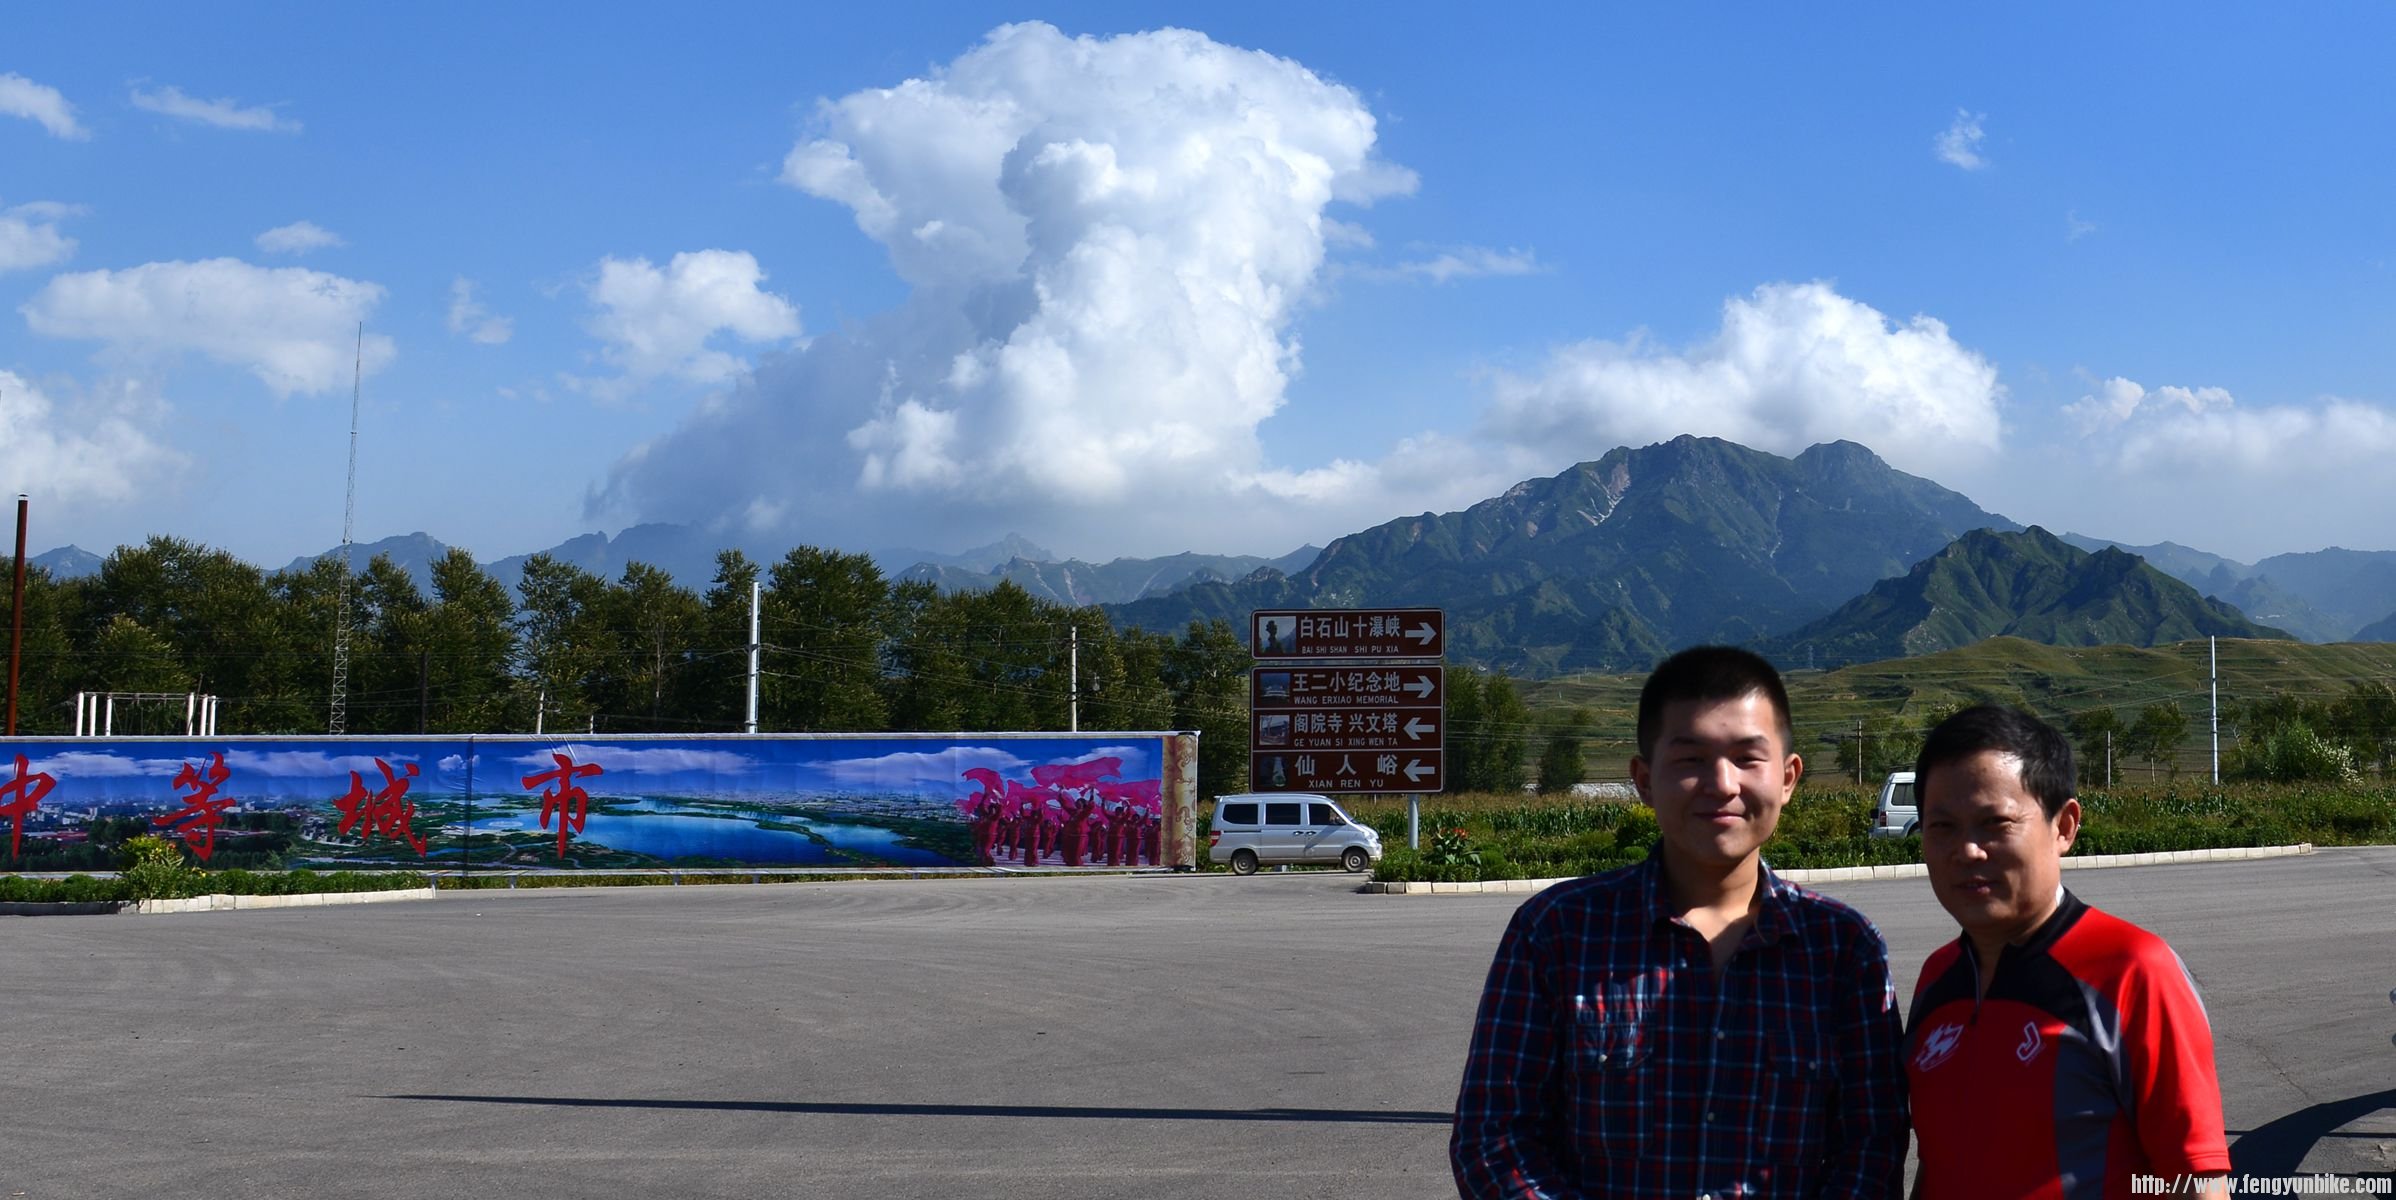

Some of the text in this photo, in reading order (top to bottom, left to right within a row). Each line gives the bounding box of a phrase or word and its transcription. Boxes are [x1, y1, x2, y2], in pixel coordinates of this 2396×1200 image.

[1300, 615, 1400, 638] 白石山十瀑峡
[1302, 645, 1399, 654] BAI SHI SHAN SHI PU XIA
[1292, 672, 1400, 692] 王二小纪念地
[1294, 695, 1399, 705] WANG ERXIAO MEMORIAL
[1294, 713, 1398, 733] 阁院寺 兴文塔
[1294, 738, 1398, 747] GE YUAN SI XING WEN TA
[1294, 754, 1398, 776] 仙人峪
[1308, 779, 1384, 789] XIAN REN YU
[0, 750, 604, 863] 中等城市
